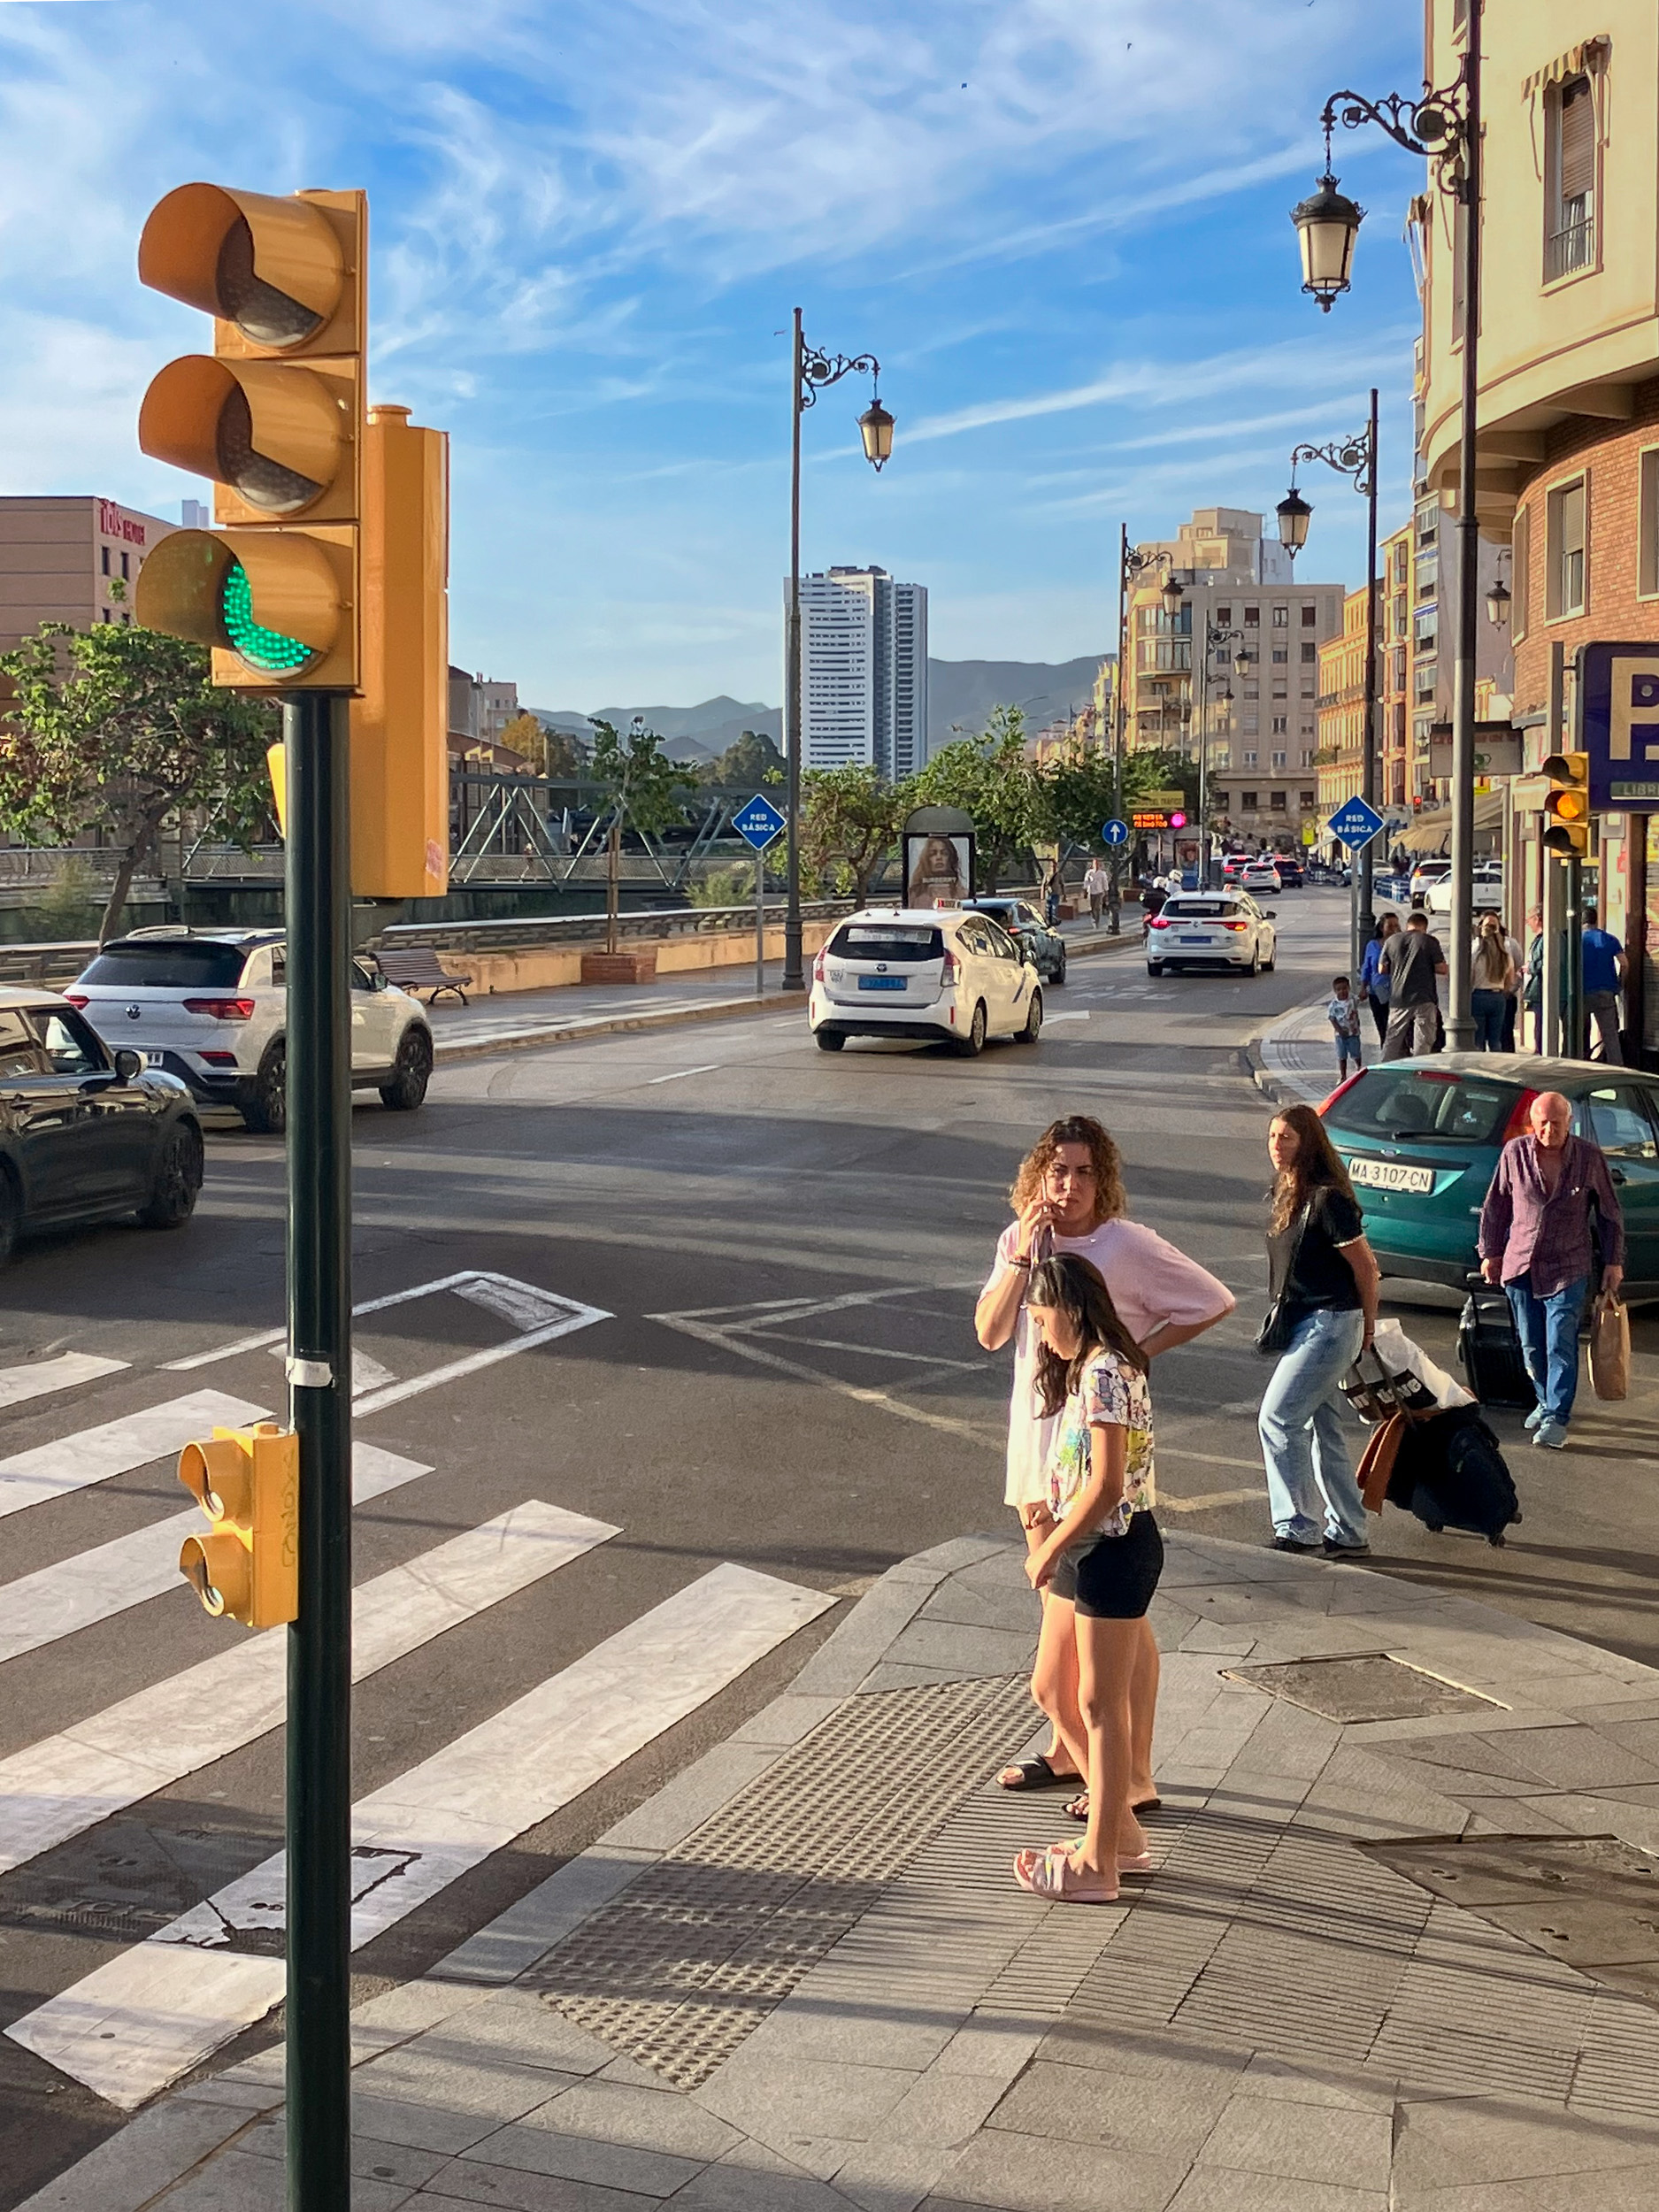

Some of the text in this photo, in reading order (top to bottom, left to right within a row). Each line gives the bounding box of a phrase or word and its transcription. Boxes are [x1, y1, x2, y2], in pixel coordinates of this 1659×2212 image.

[1624, 784, 1659, 796] LIBR
[749, 813, 768, 822] RED
[1345, 814, 1365, 823] RED
[741, 822, 776, 832] BÁSICA
[1337, 823, 1373, 833] BÁSICA
